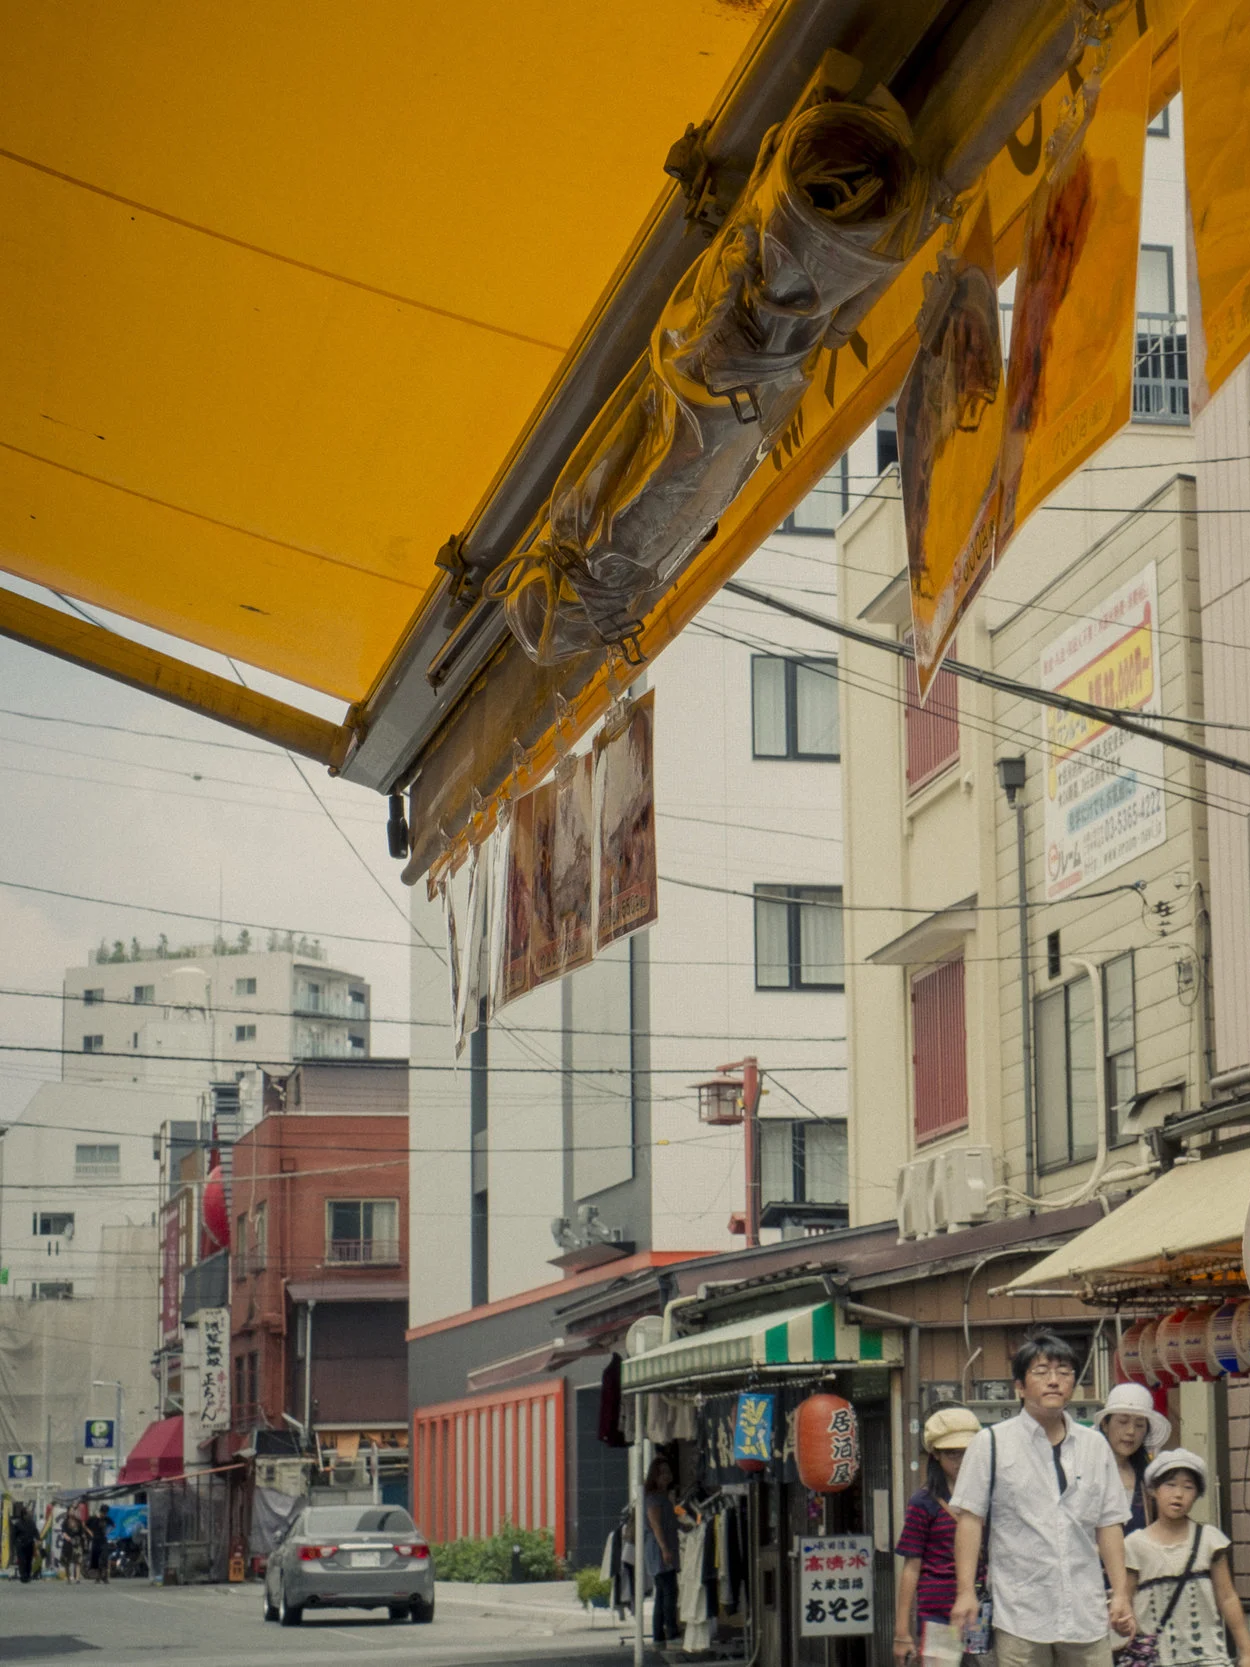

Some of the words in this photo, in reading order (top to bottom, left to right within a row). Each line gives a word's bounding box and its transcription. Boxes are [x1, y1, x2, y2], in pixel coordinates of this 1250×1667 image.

[829, 1406, 853, 1486] 居酒屋
[805, 1597, 870, 1624] あそこ
